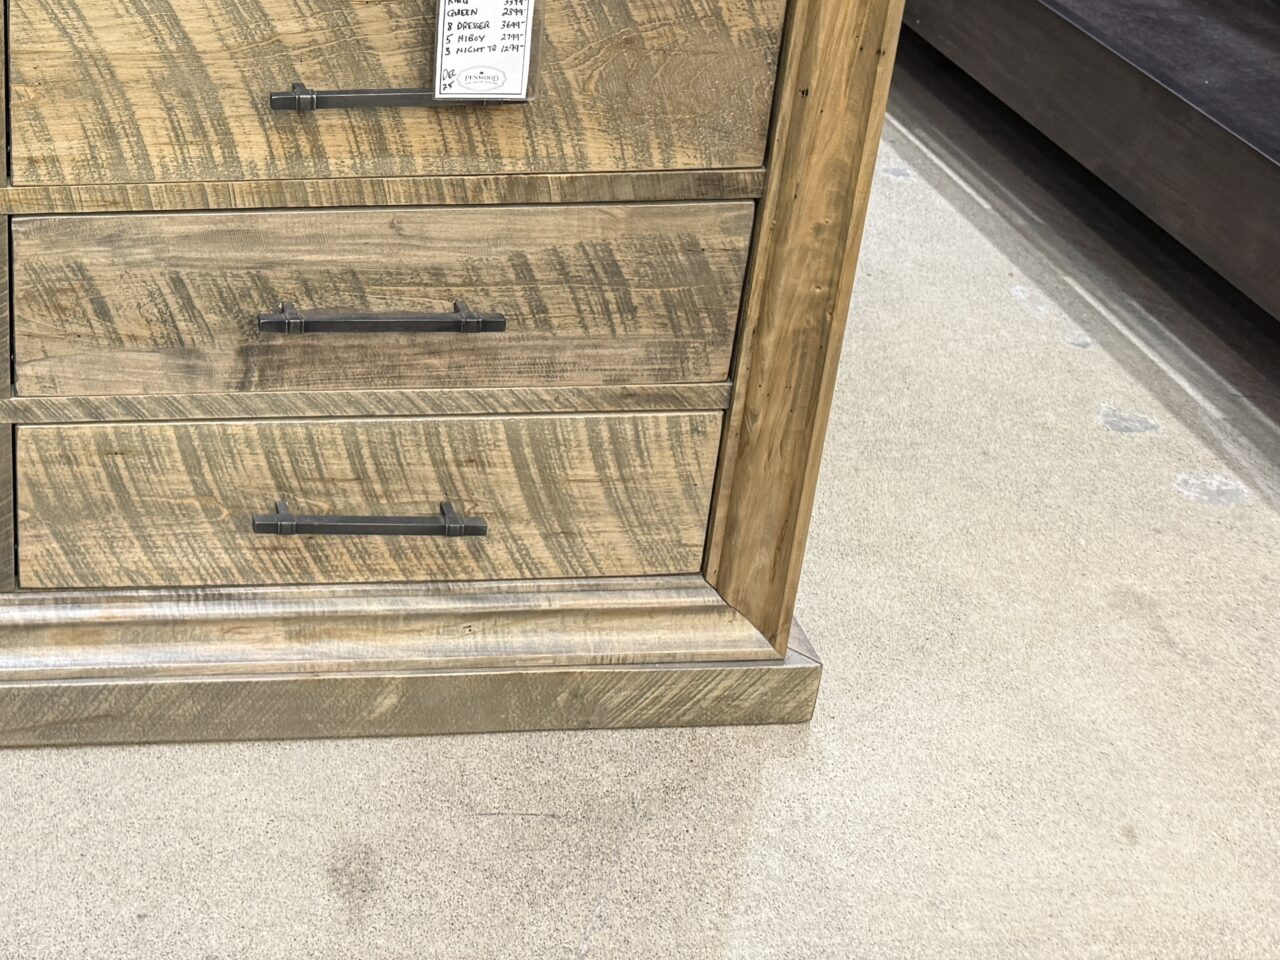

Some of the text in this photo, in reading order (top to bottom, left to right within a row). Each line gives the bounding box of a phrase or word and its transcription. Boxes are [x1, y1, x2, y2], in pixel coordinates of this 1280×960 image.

[447, 7, 478, 17] QUEEN
[447, 21, 453, 31] 8
[457, 20, 490, 30] DRESSER
[445, 33, 454, 44] 5
[444, 46, 451, 55] 3
[442, 80, 455, 91] 25
